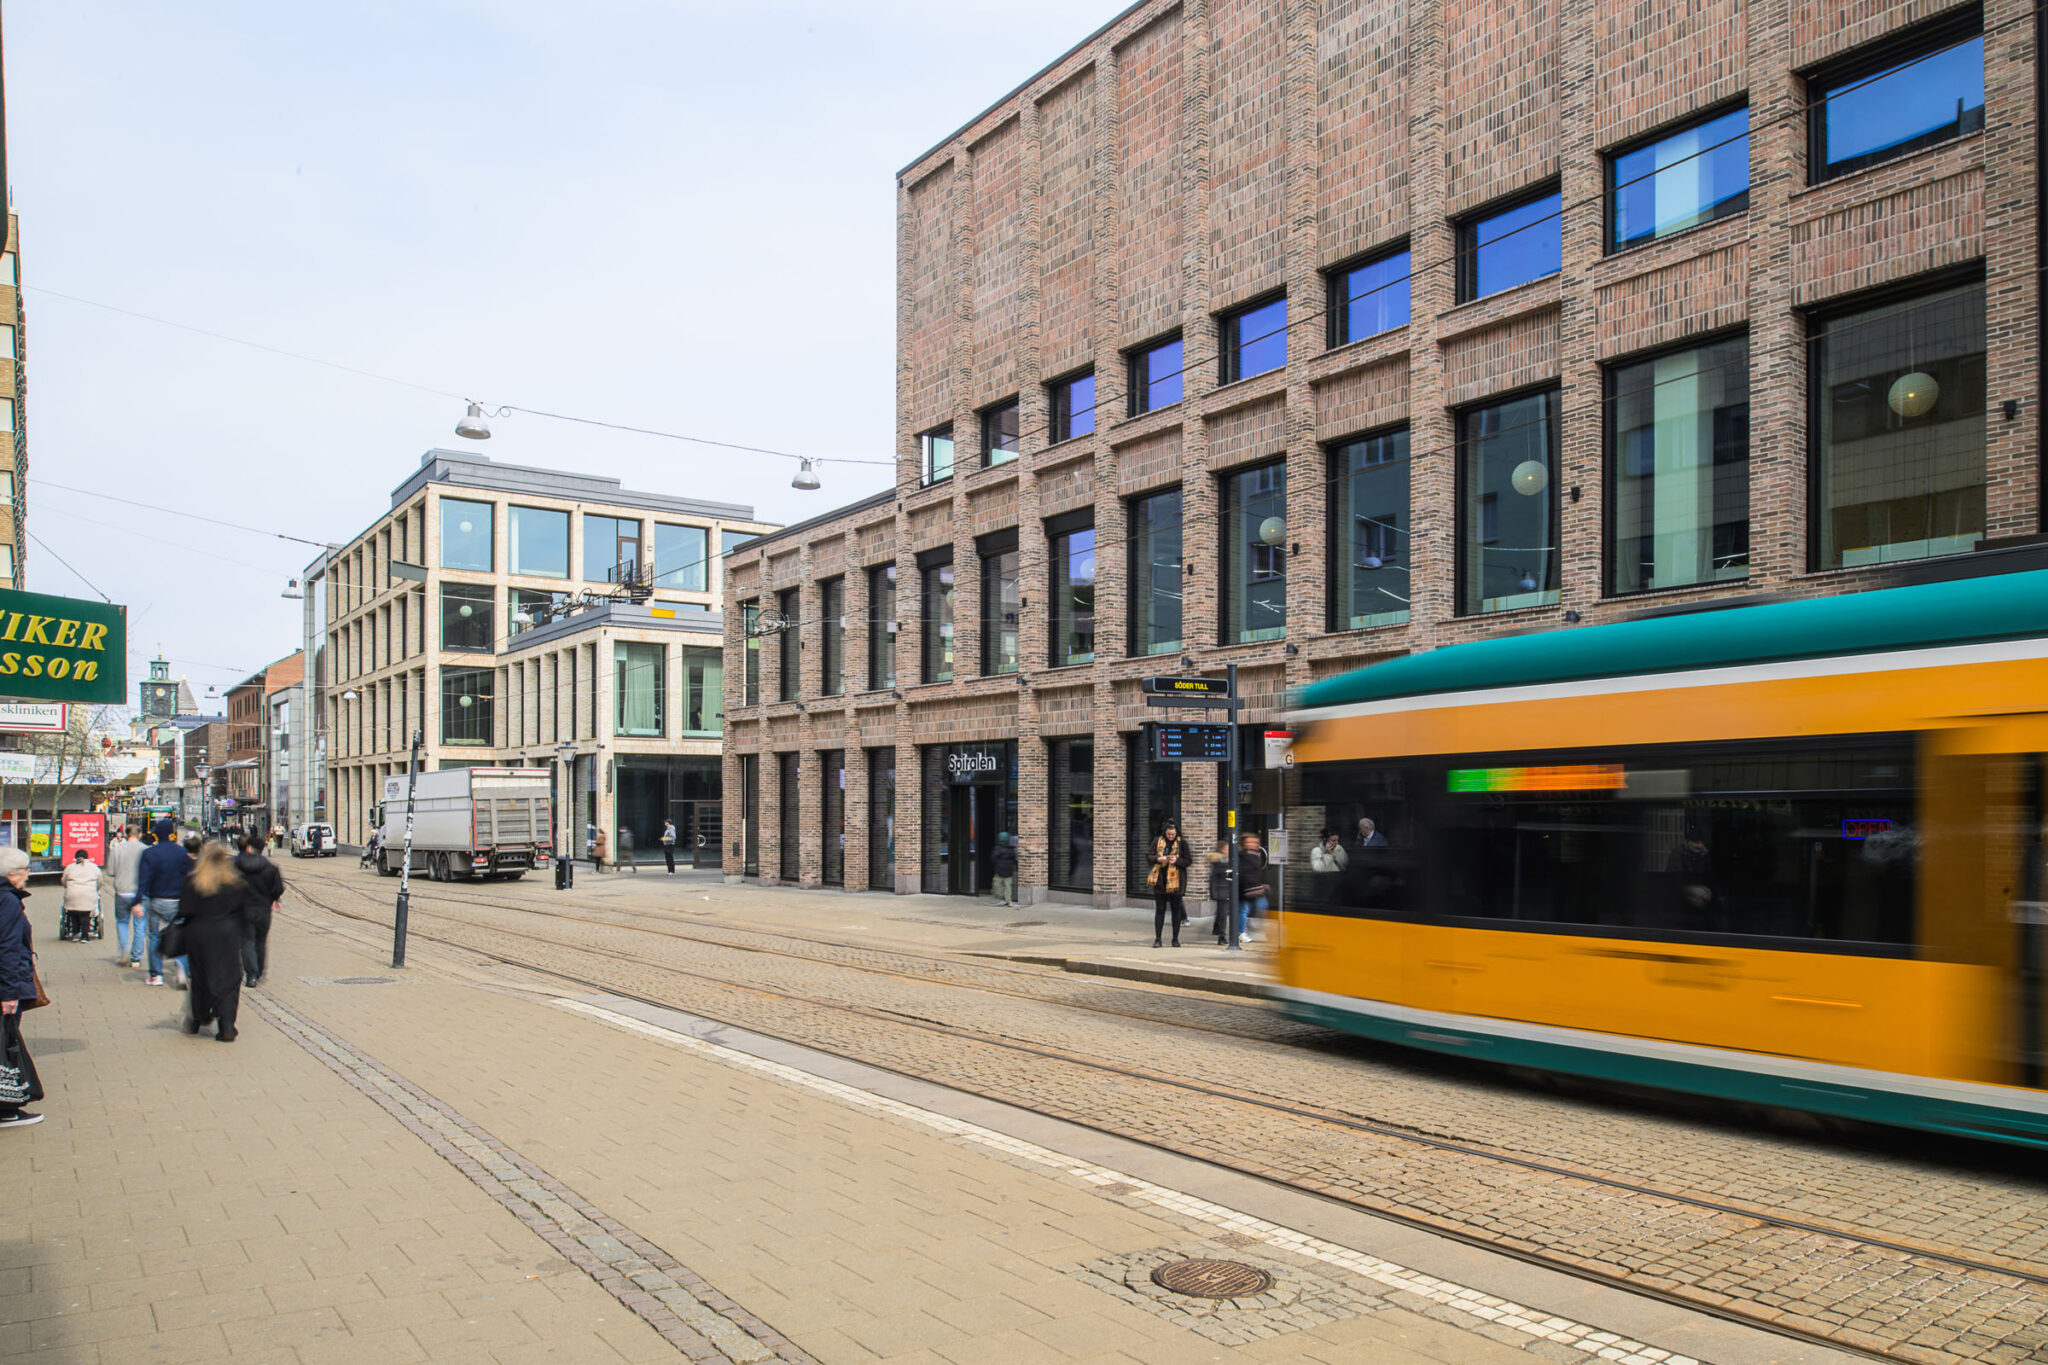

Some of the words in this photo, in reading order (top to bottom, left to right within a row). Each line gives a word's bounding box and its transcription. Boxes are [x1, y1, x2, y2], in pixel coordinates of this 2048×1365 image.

[0, 609, 108, 651] IKER
[1174, 681, 1194, 690] SÖDER
[1, 704, 57, 716] skliniken
[948, 752, 996, 776] Spiralen
[1285, 754, 1293, 765] G
[1846, 822, 1890, 837] OPEN
